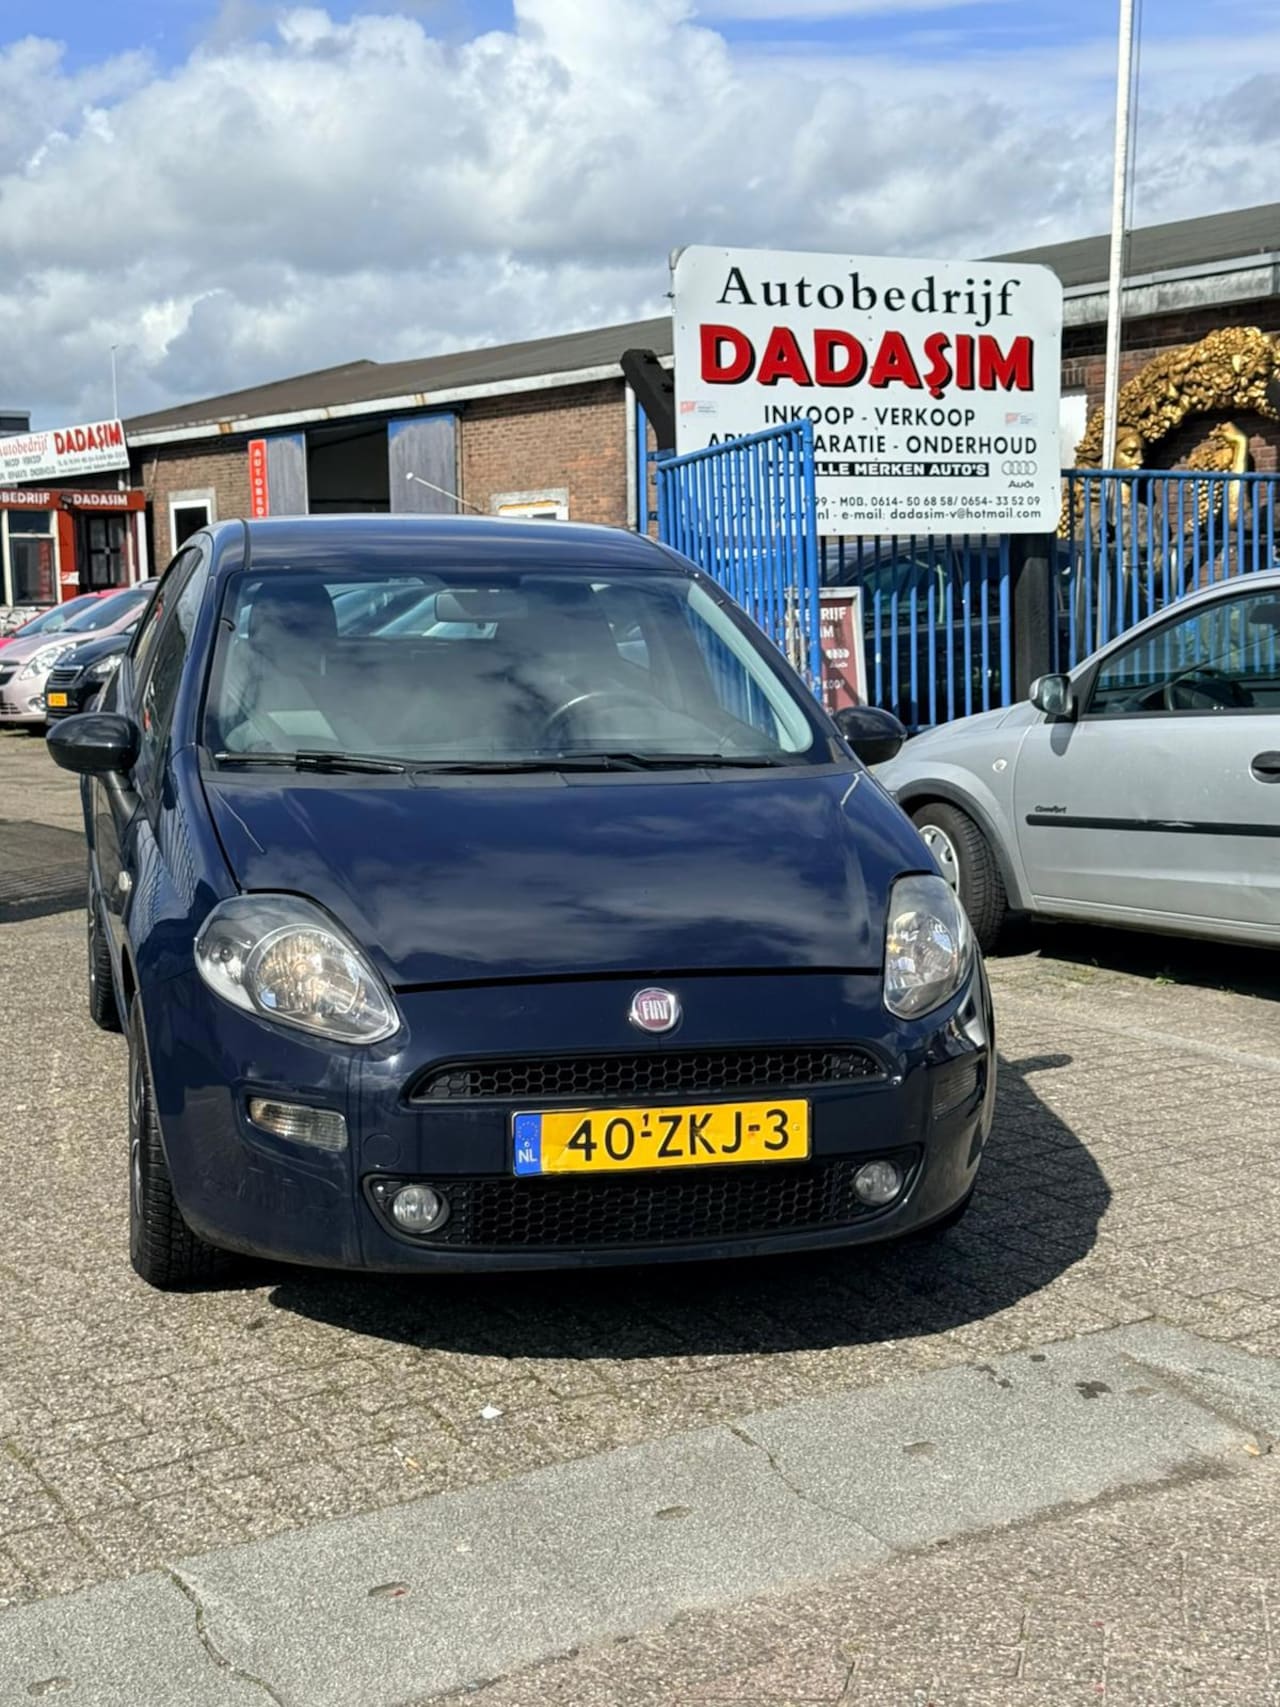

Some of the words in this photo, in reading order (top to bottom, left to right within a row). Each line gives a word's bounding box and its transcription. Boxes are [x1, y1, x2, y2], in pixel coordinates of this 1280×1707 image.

[716, 266, 1021, 327] Autobedrijf
[699, 323, 1034, 399] DADAŞIM
[764, 404, 855, 425] INKOOP
[874, 407, 975, 427] VERKOOP
[0, 434, 48, 457] utobedrijf
[906, 435, 1037, 454] ONDERHOUD
[814, 463, 850, 475] LLE
[854, 463, 925, 476] MERKEN
[928, 463, 987, 476] AUTO'S
[1008, 480, 1034, 489] Audi
[0, 491, 51, 505] BEDRIJF
[906, 496, 921, 506] 50
[923, 496, 938, 506] 68
[995, 496, 1009, 506] 33
[1011, 496, 1025, 506] 52
[1027, 495, 1041, 506] 09
[642, 1000, 669, 1020] FIAT
[567, 1108, 789, 1162] 40-ZKJ-3
[518, 1148, 538, 1163] NL
